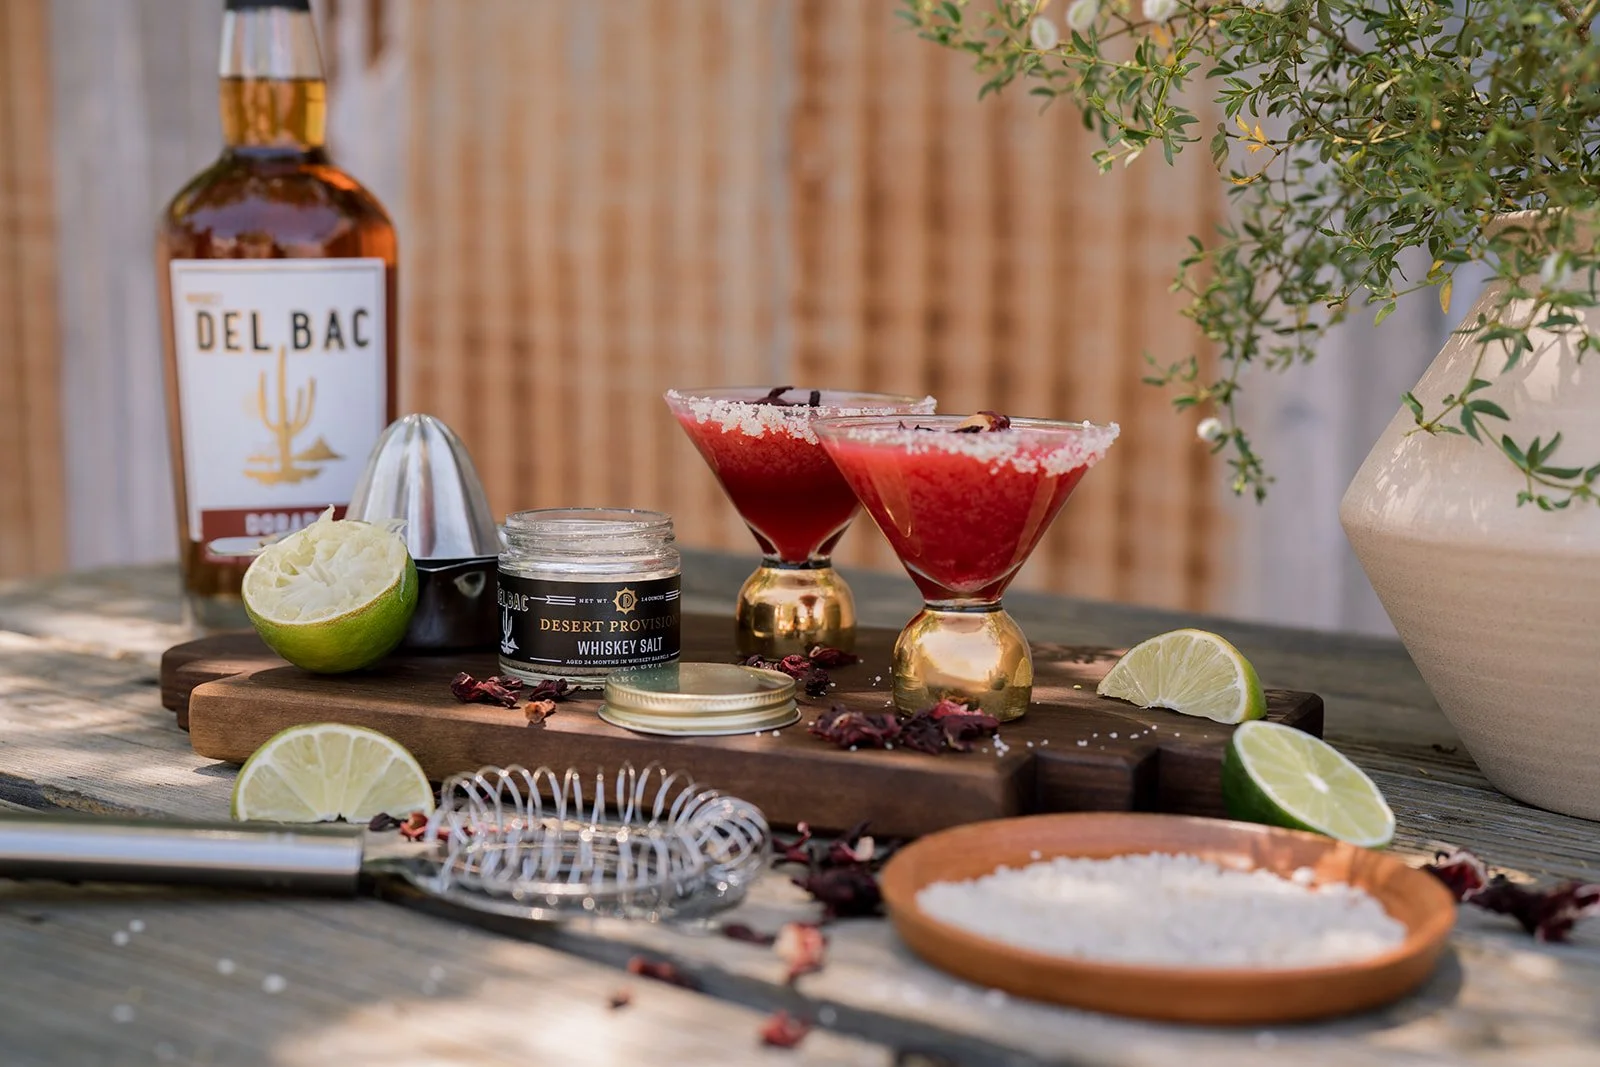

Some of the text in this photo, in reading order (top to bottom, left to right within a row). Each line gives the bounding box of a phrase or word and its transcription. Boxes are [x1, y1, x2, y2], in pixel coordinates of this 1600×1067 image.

[196, 308, 370, 351] DEL BAC
[540, 618, 604, 633] DESERT
[577, 637, 663, 655] WHISKEY SALT
[628, 656, 651, 664] WHISKEY
